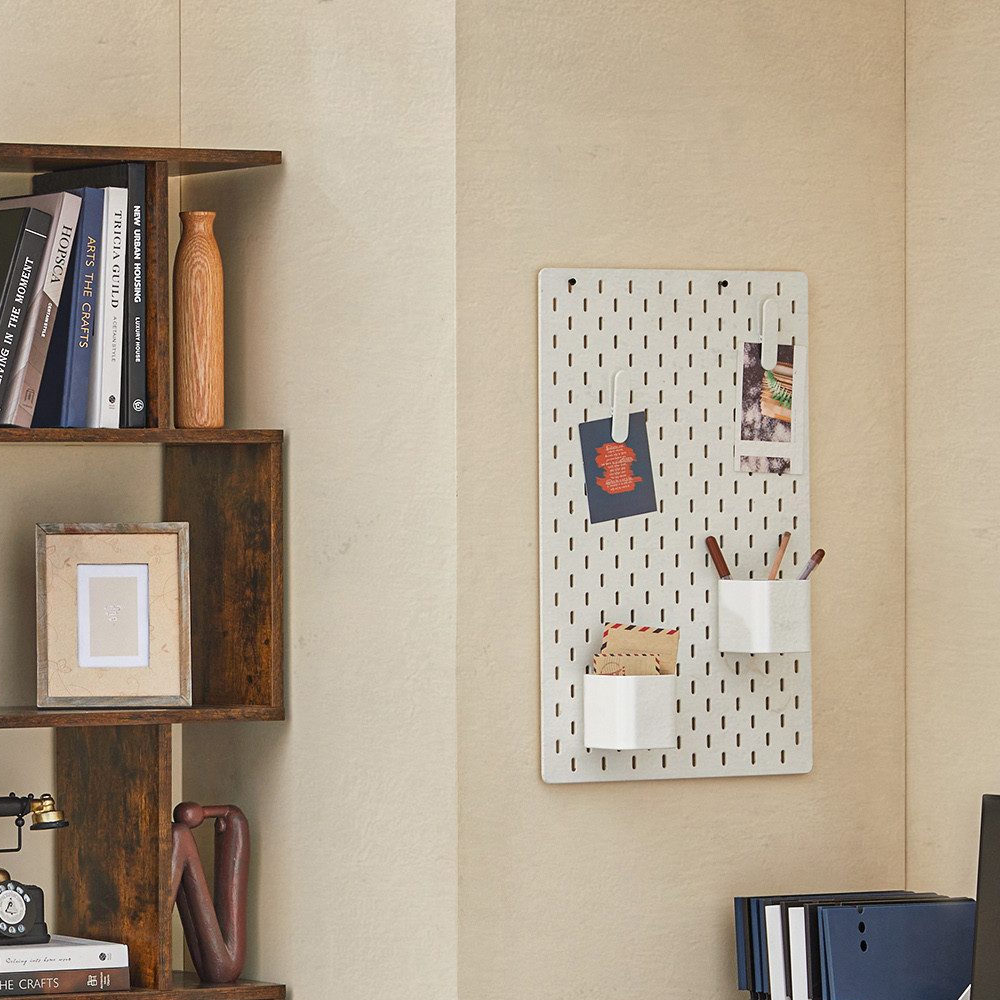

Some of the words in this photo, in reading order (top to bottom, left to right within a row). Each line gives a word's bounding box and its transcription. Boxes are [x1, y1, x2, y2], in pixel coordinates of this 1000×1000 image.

[133, 205, 141, 227] NEW
[85, 235, 97, 267] ARTS
[113, 210, 123, 260] TRICIA
[133, 229, 141, 260] URBAN
[51, 225, 73, 283] HOPSCA
[14, 256, 34, 304] MOMENT
[83, 272, 94, 298] THE
[111, 264, 120, 308] GUILD
[133, 263, 142, 303] HOUSING
[8, 306, 21, 328] THE
[79, 302, 92, 348] CRAFTS
[4, 332, 14, 345] IN
[19, 977, 59, 990] CRAFTS
